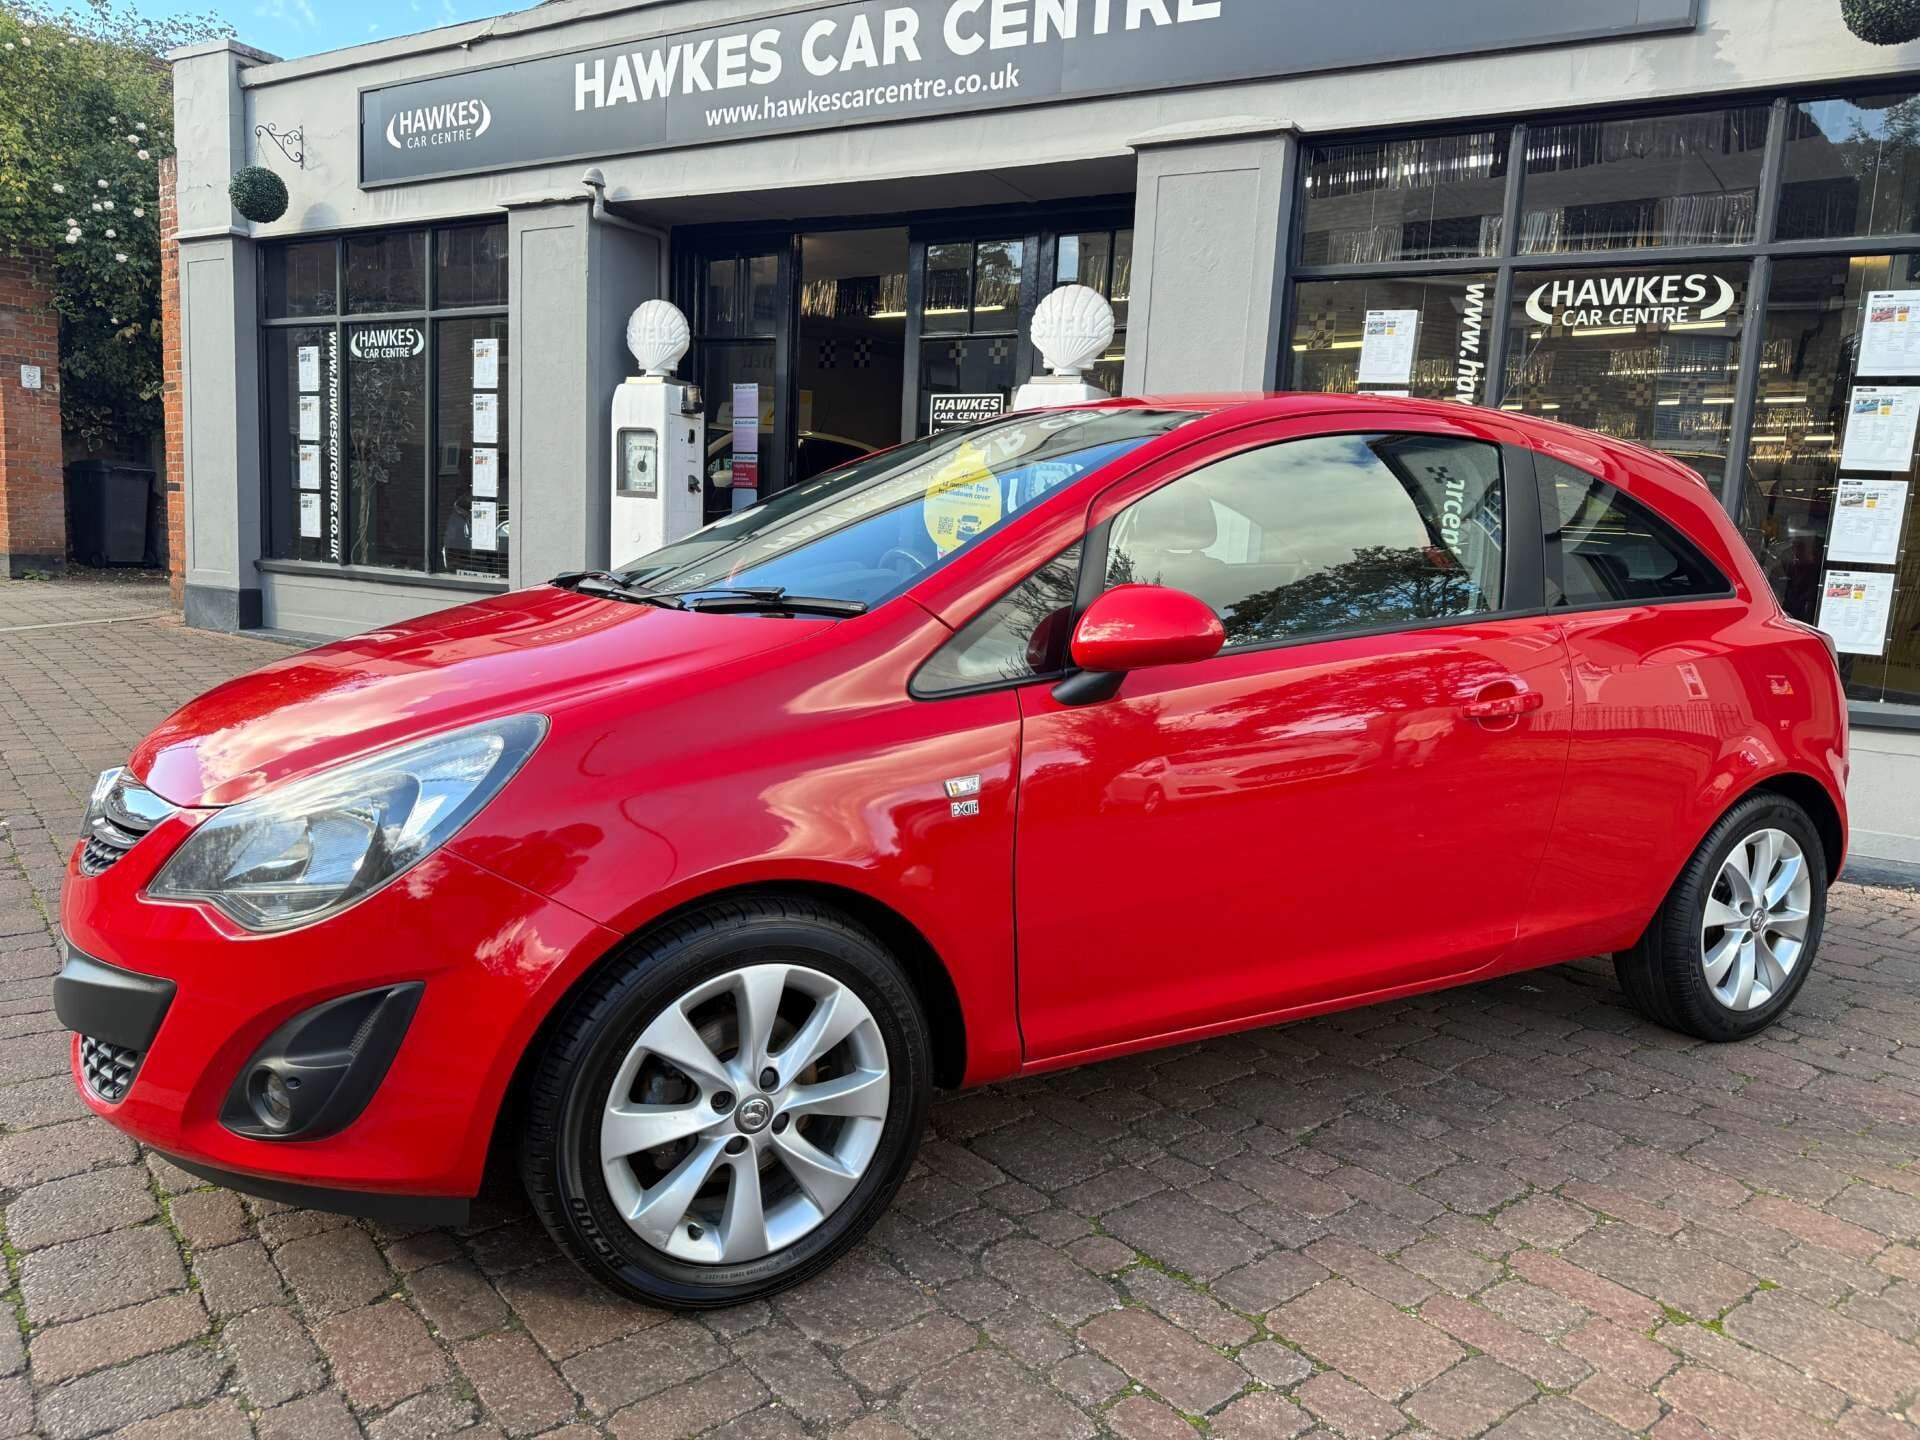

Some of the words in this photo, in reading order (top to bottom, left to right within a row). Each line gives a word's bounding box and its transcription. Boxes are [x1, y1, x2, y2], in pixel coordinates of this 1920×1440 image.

[574, 28, 782, 111] HAWKES
[801, 7, 922, 77] CAR
[705, 61, 1020, 126] www.hawkescarcentre.co.uk
[400, 99, 480, 135] HAWKES
[407, 135, 427, 149] CAR
[431, 128, 472, 145] CENTRE
[1551, 273, 1707, 307] HAWKES
[1562, 309, 1602, 327] CAR
[1609, 306, 1689, 325] CENTRE
[360, 328, 414, 347] HAWKES
[364, 348, 380, 359] CAR
[381, 347, 411, 358] CENTRE
[934, 398, 999, 411] HAWKES
[933, 411, 954, 420] CAR
[329, 331, 339, 560] www.hawkescarcentre.co.uk
